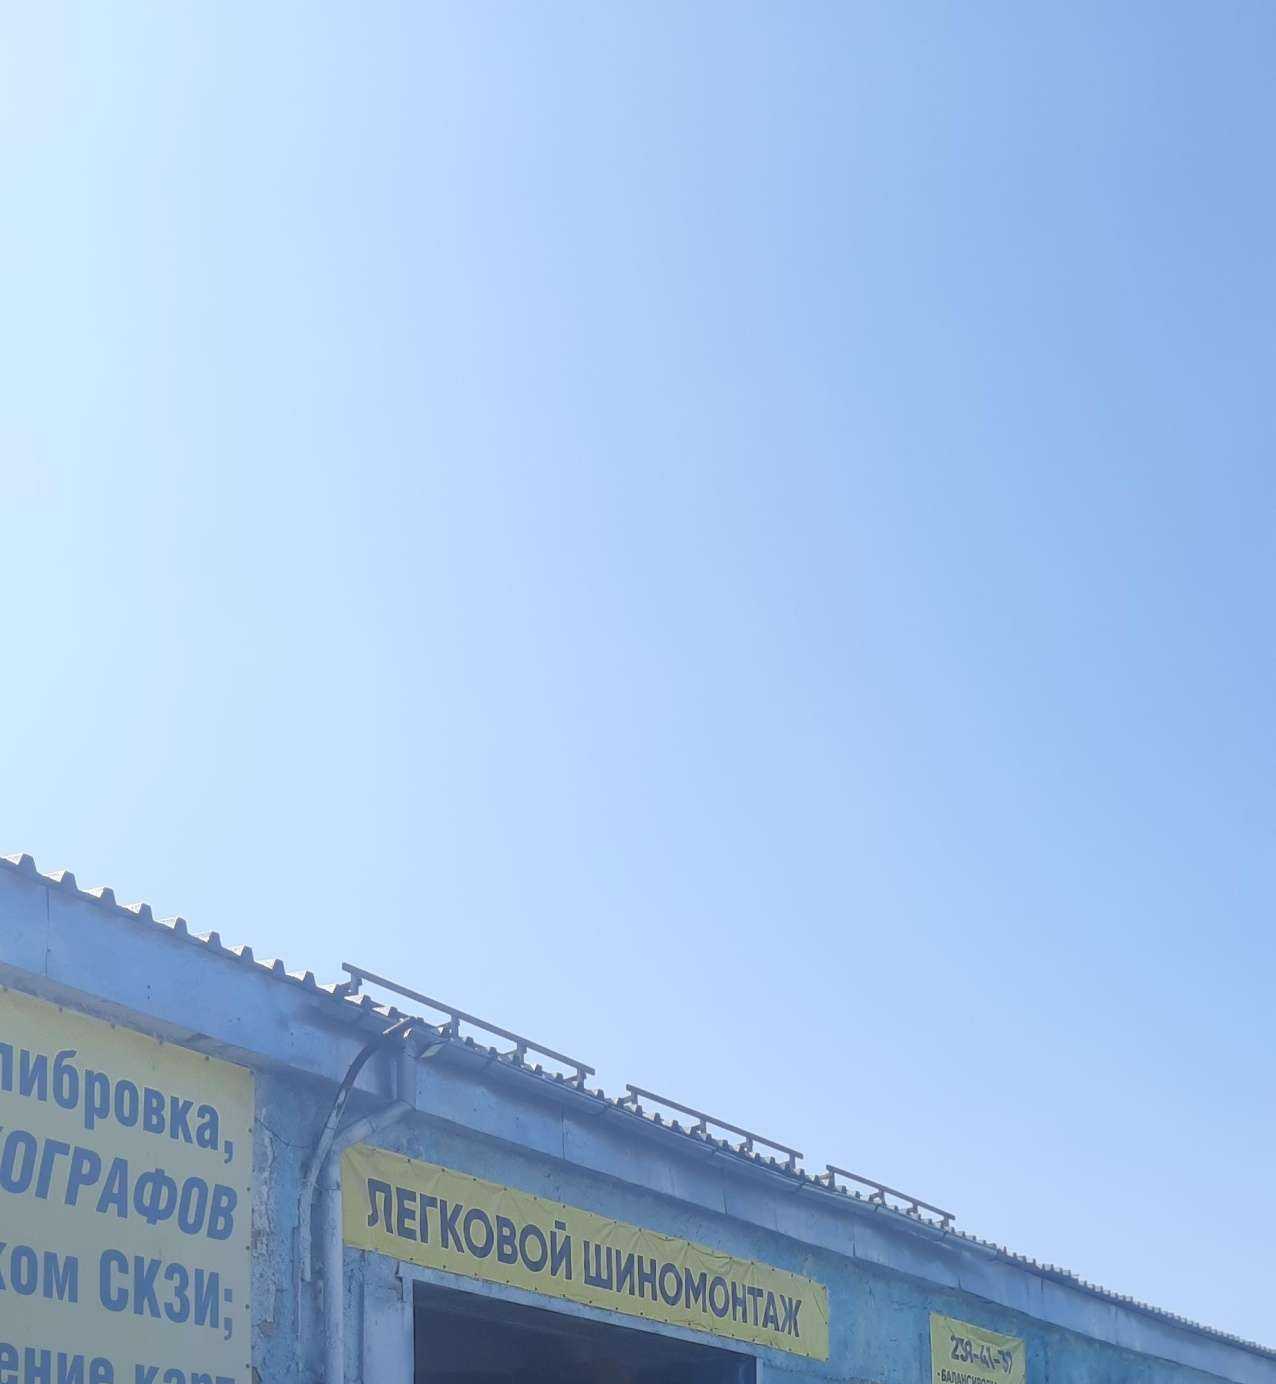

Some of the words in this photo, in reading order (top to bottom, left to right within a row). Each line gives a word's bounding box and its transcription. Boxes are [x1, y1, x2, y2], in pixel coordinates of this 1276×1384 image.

[0, 1126, 238, 1241] ОГРАФОВ
[0, 1242, 79, 1304] ом
[99, 1248, 234, 1341] СКЗИ;
[366, 1177, 574, 1281] ЛЕГКОВОЙ
[583, 1240, 803, 1339] ШИНОМОНТАЖ
